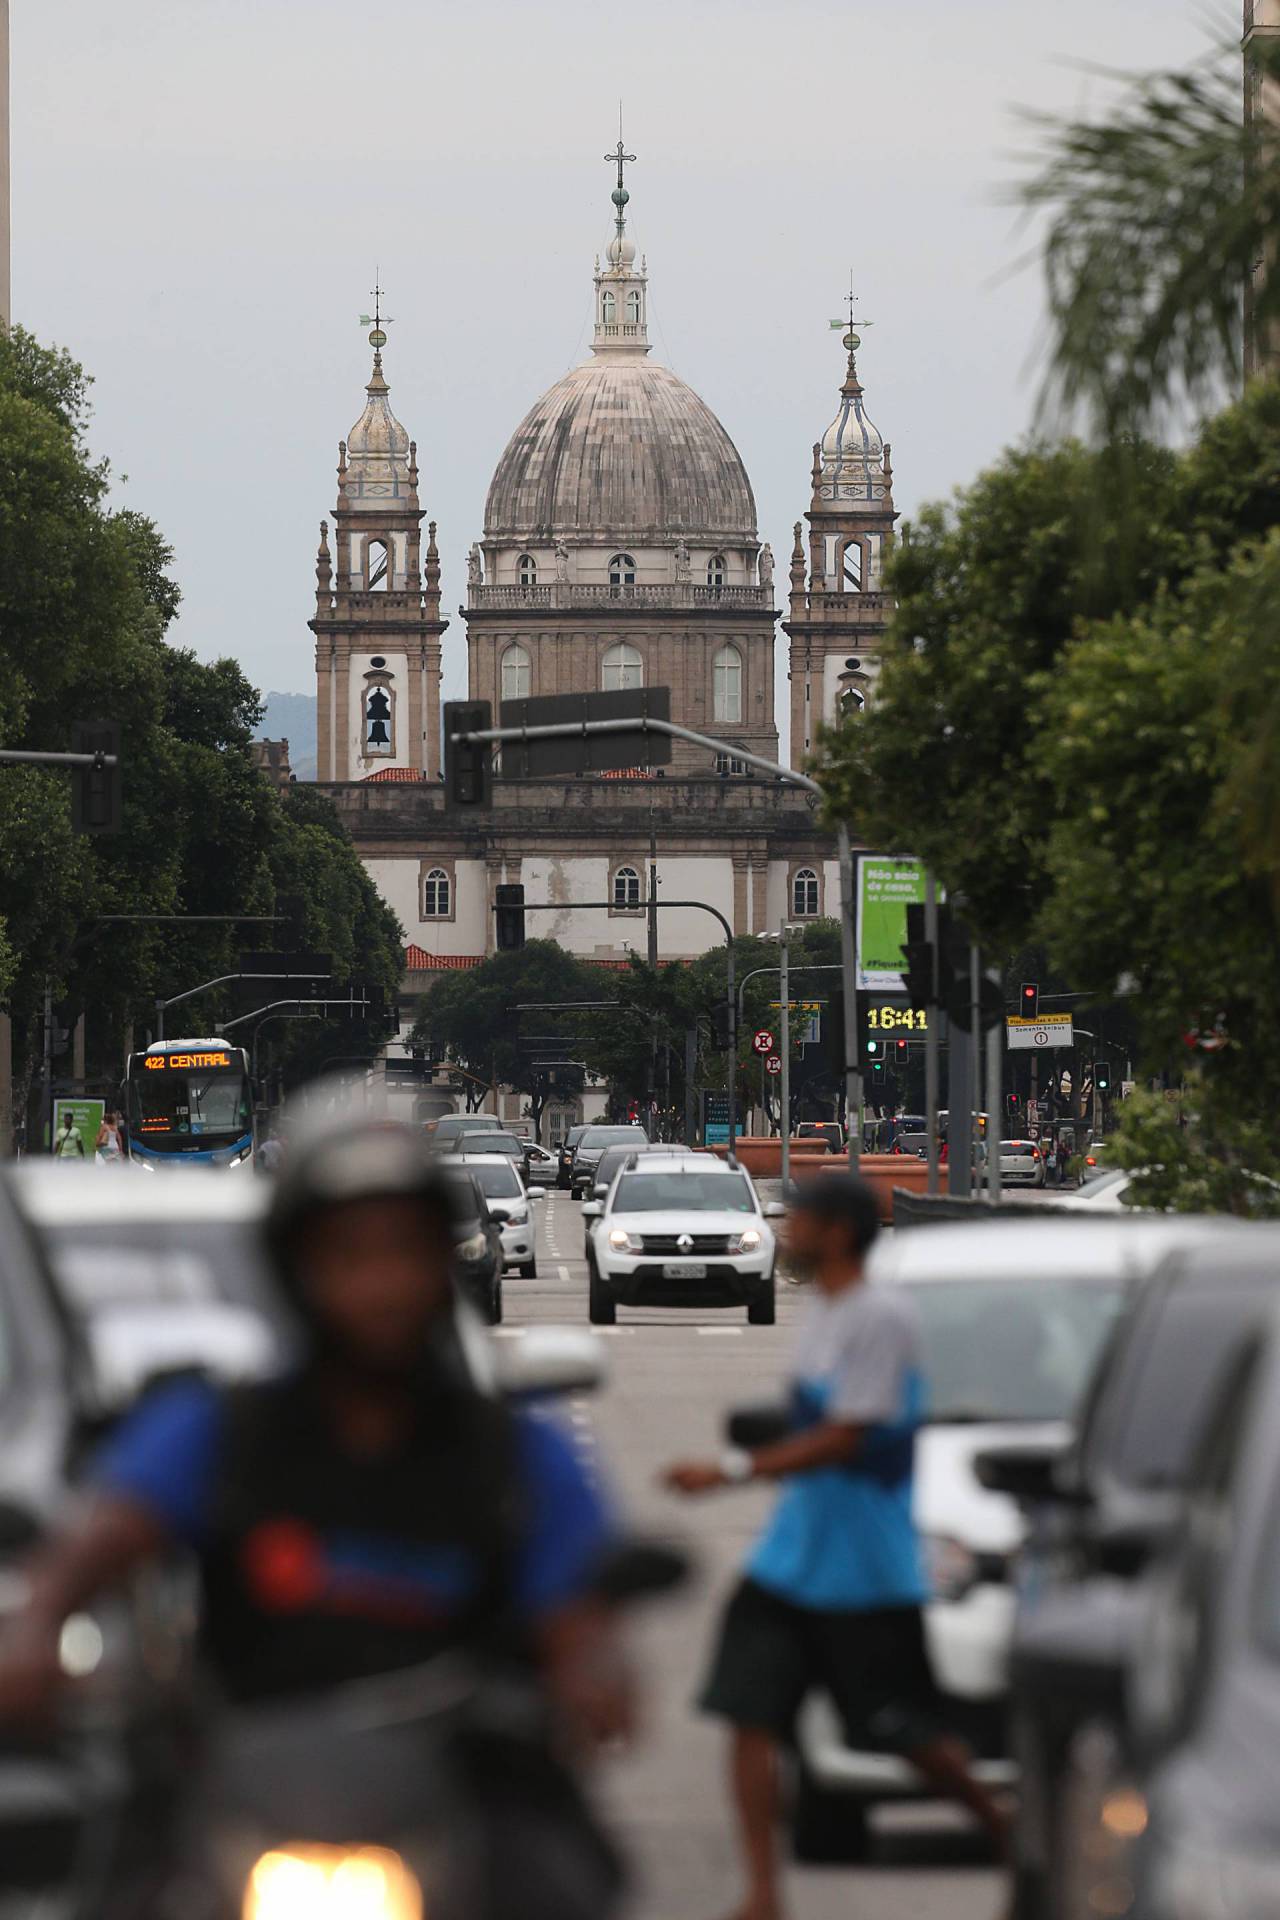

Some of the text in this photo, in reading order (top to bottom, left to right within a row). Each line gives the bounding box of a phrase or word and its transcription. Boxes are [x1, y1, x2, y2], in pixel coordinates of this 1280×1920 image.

[867, 1006, 928, 1029] 16:41
[145, 1052, 230, 1069] 422 CENTRAL
